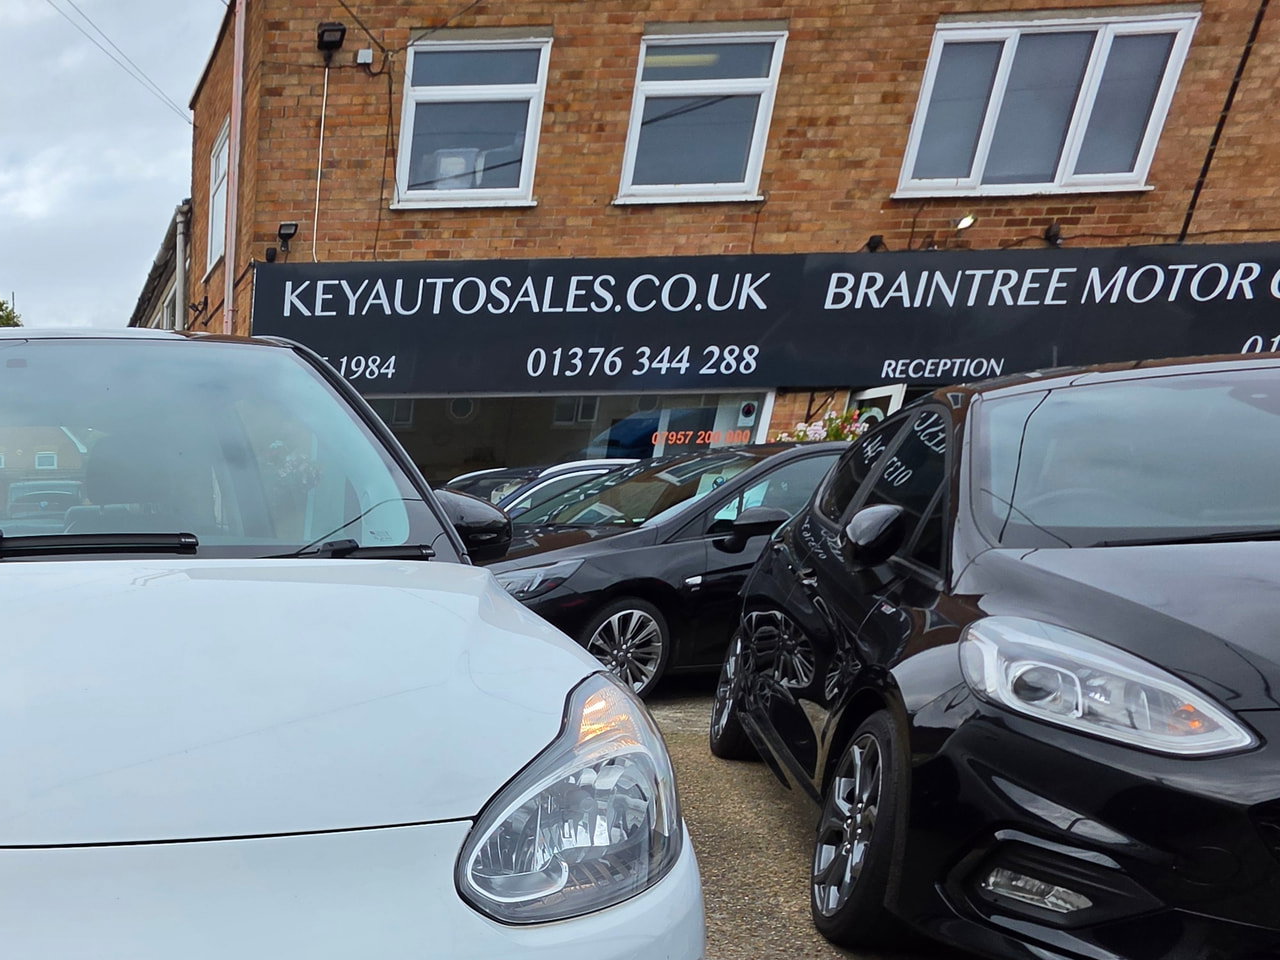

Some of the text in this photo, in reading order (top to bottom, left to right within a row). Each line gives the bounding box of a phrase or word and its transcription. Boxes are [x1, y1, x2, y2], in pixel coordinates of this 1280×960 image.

[283, 272, 771, 317] KEYAUTOSALES.CO.UK
[823, 267, 1078, 310] BRAINTREE
[1081, 262, 1261, 304] MOTOR
[340, 355, 396, 379] 1984
[526, 344, 760, 377] 01376 344 288
[881, 358, 1005, 378] RECEPTION
[651, 431, 694, 445] 07957
